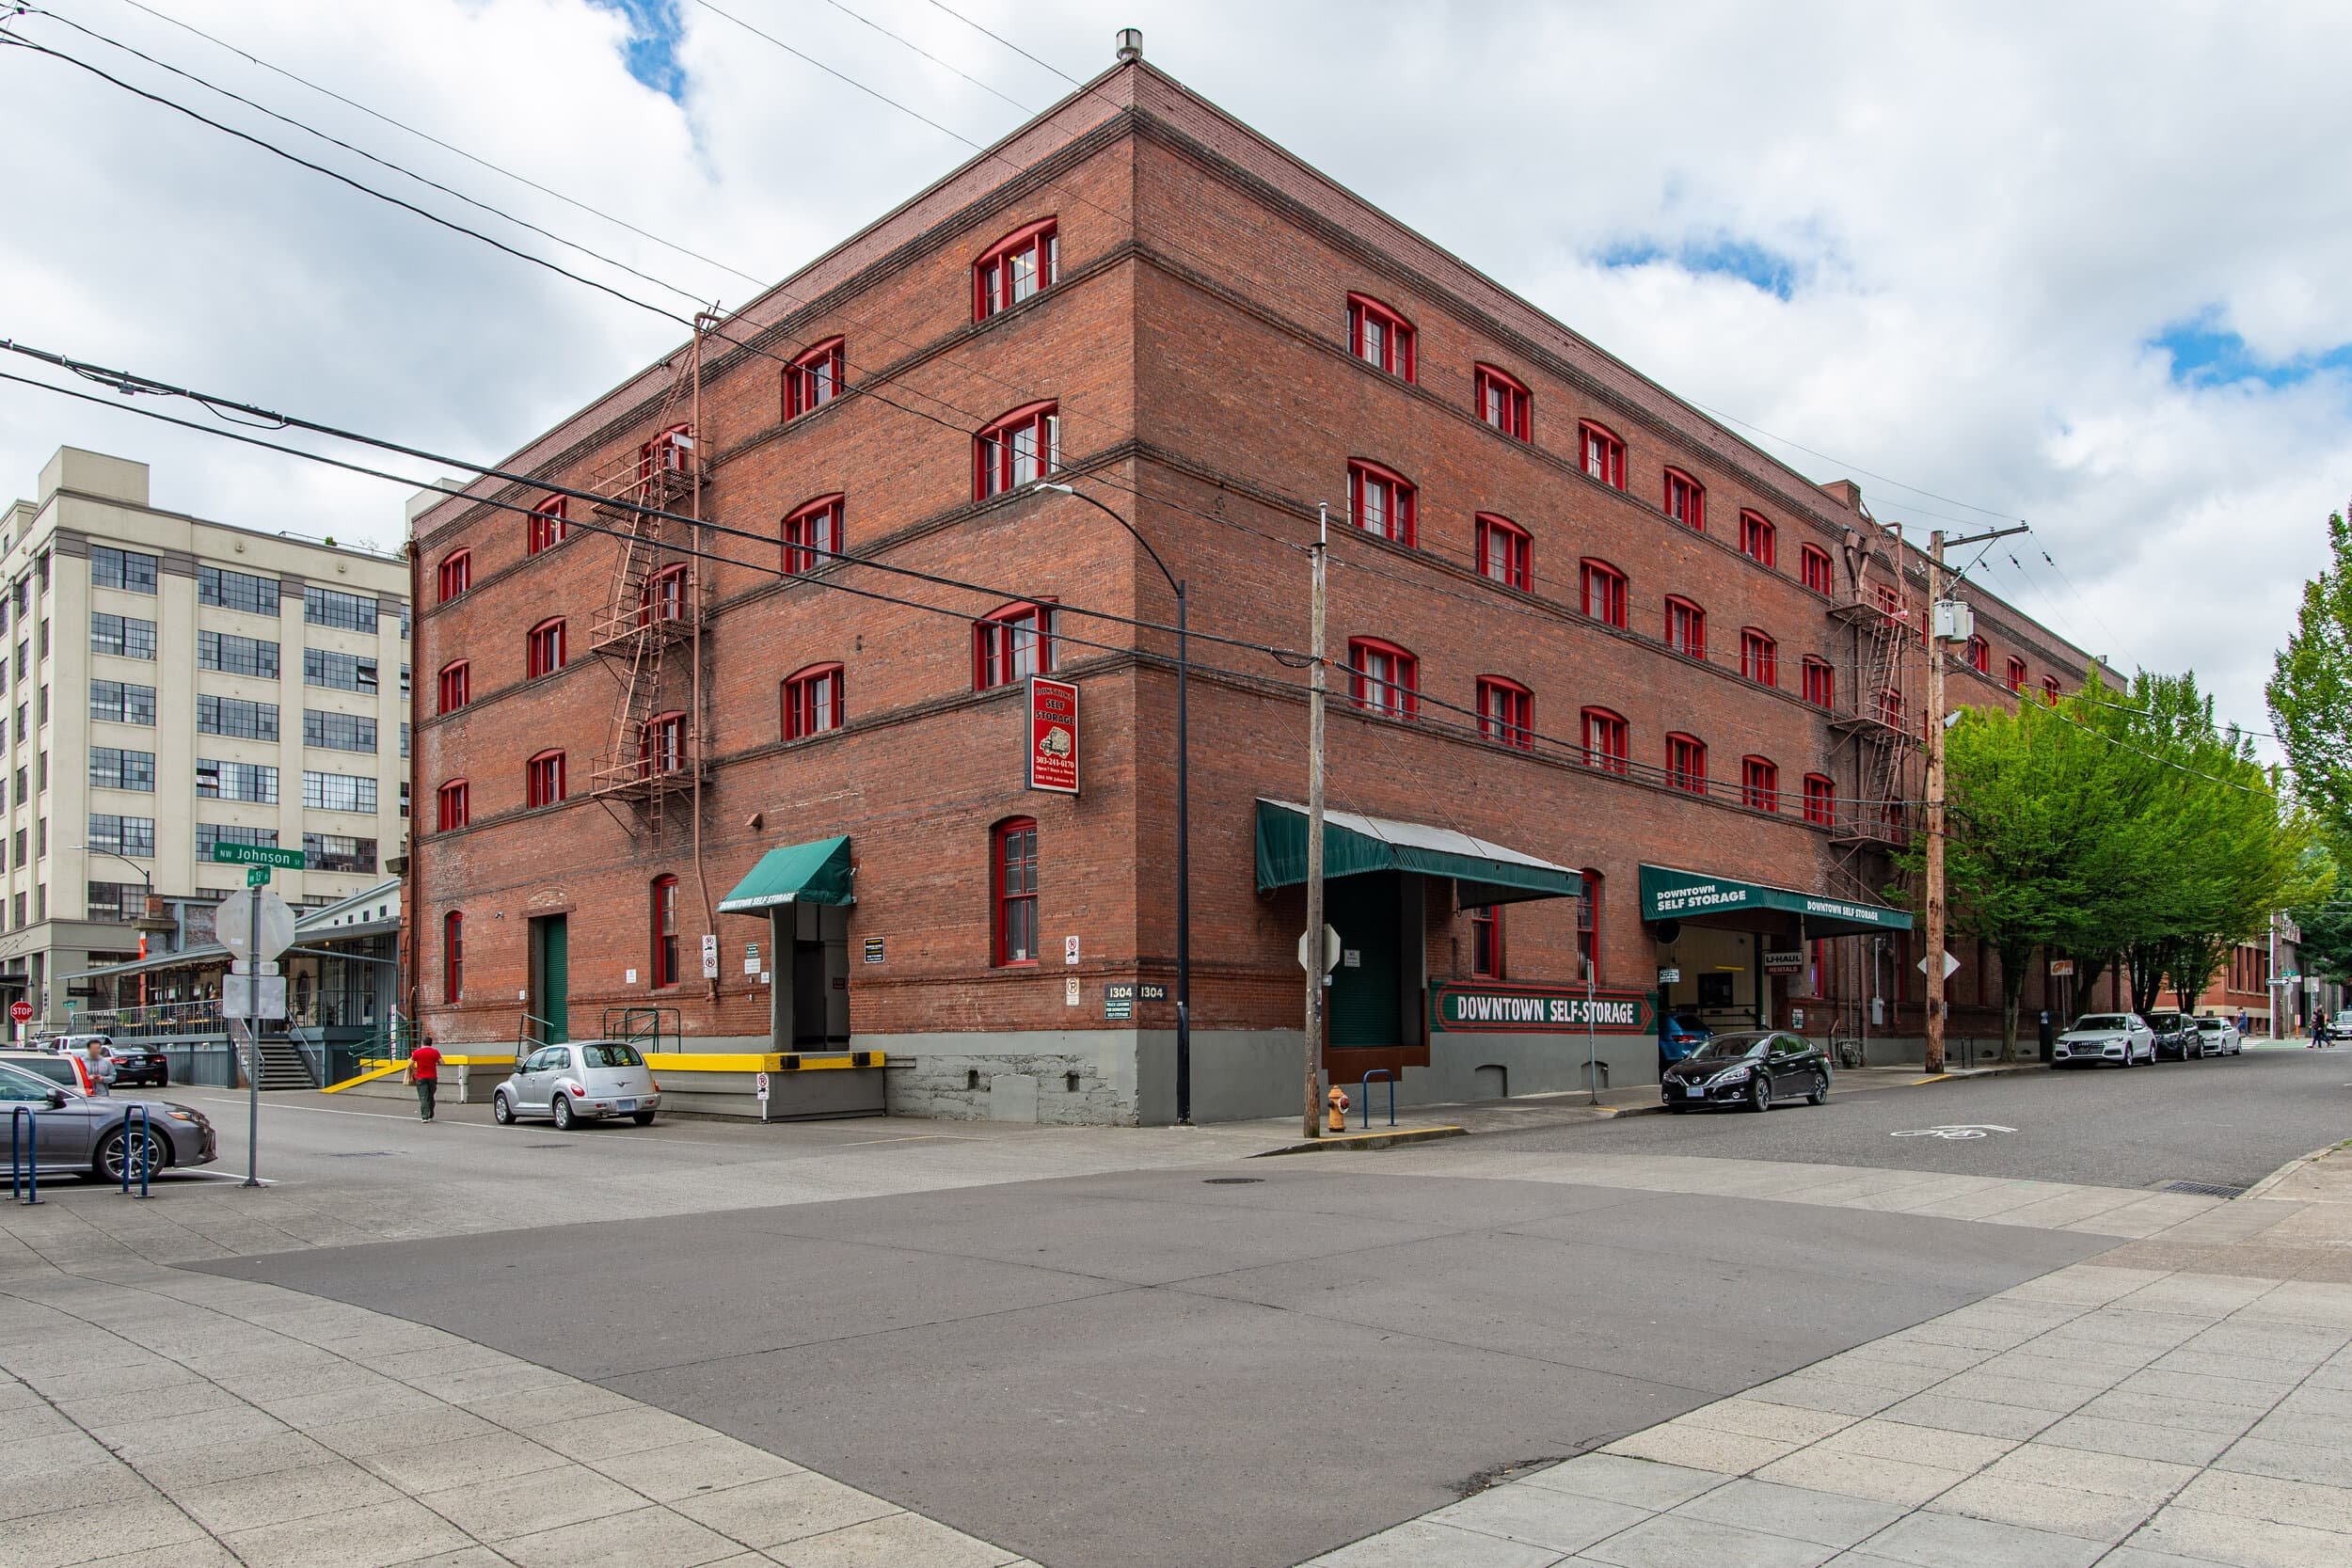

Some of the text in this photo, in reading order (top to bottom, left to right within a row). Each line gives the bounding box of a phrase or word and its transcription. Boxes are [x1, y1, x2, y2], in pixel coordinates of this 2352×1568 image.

[1046, 700, 1065, 710] SELF
[1036, 710, 1075, 725] STORAGE
[1036, 755, 1074, 768] 503-241-6170
[219, 849, 232, 859] NW
[236, 848, 290, 864] Johnson
[1657, 885, 1716, 900] DOWNTOWN
[1657, 890, 1746, 911] SELF STORAGE
[1806, 900, 1879, 921] DOWNTOWN SELF STORAGE
[1766, 955, 1801, 963] U-HAUL
[1110, 987, 1133, 998] 1304
[1141, 986, 1164, 998] 1304
[12, 1006, 32, 1016] STOP
[1457, 996, 1634, 1023] DOWNTOWN SELF-STORAGE
